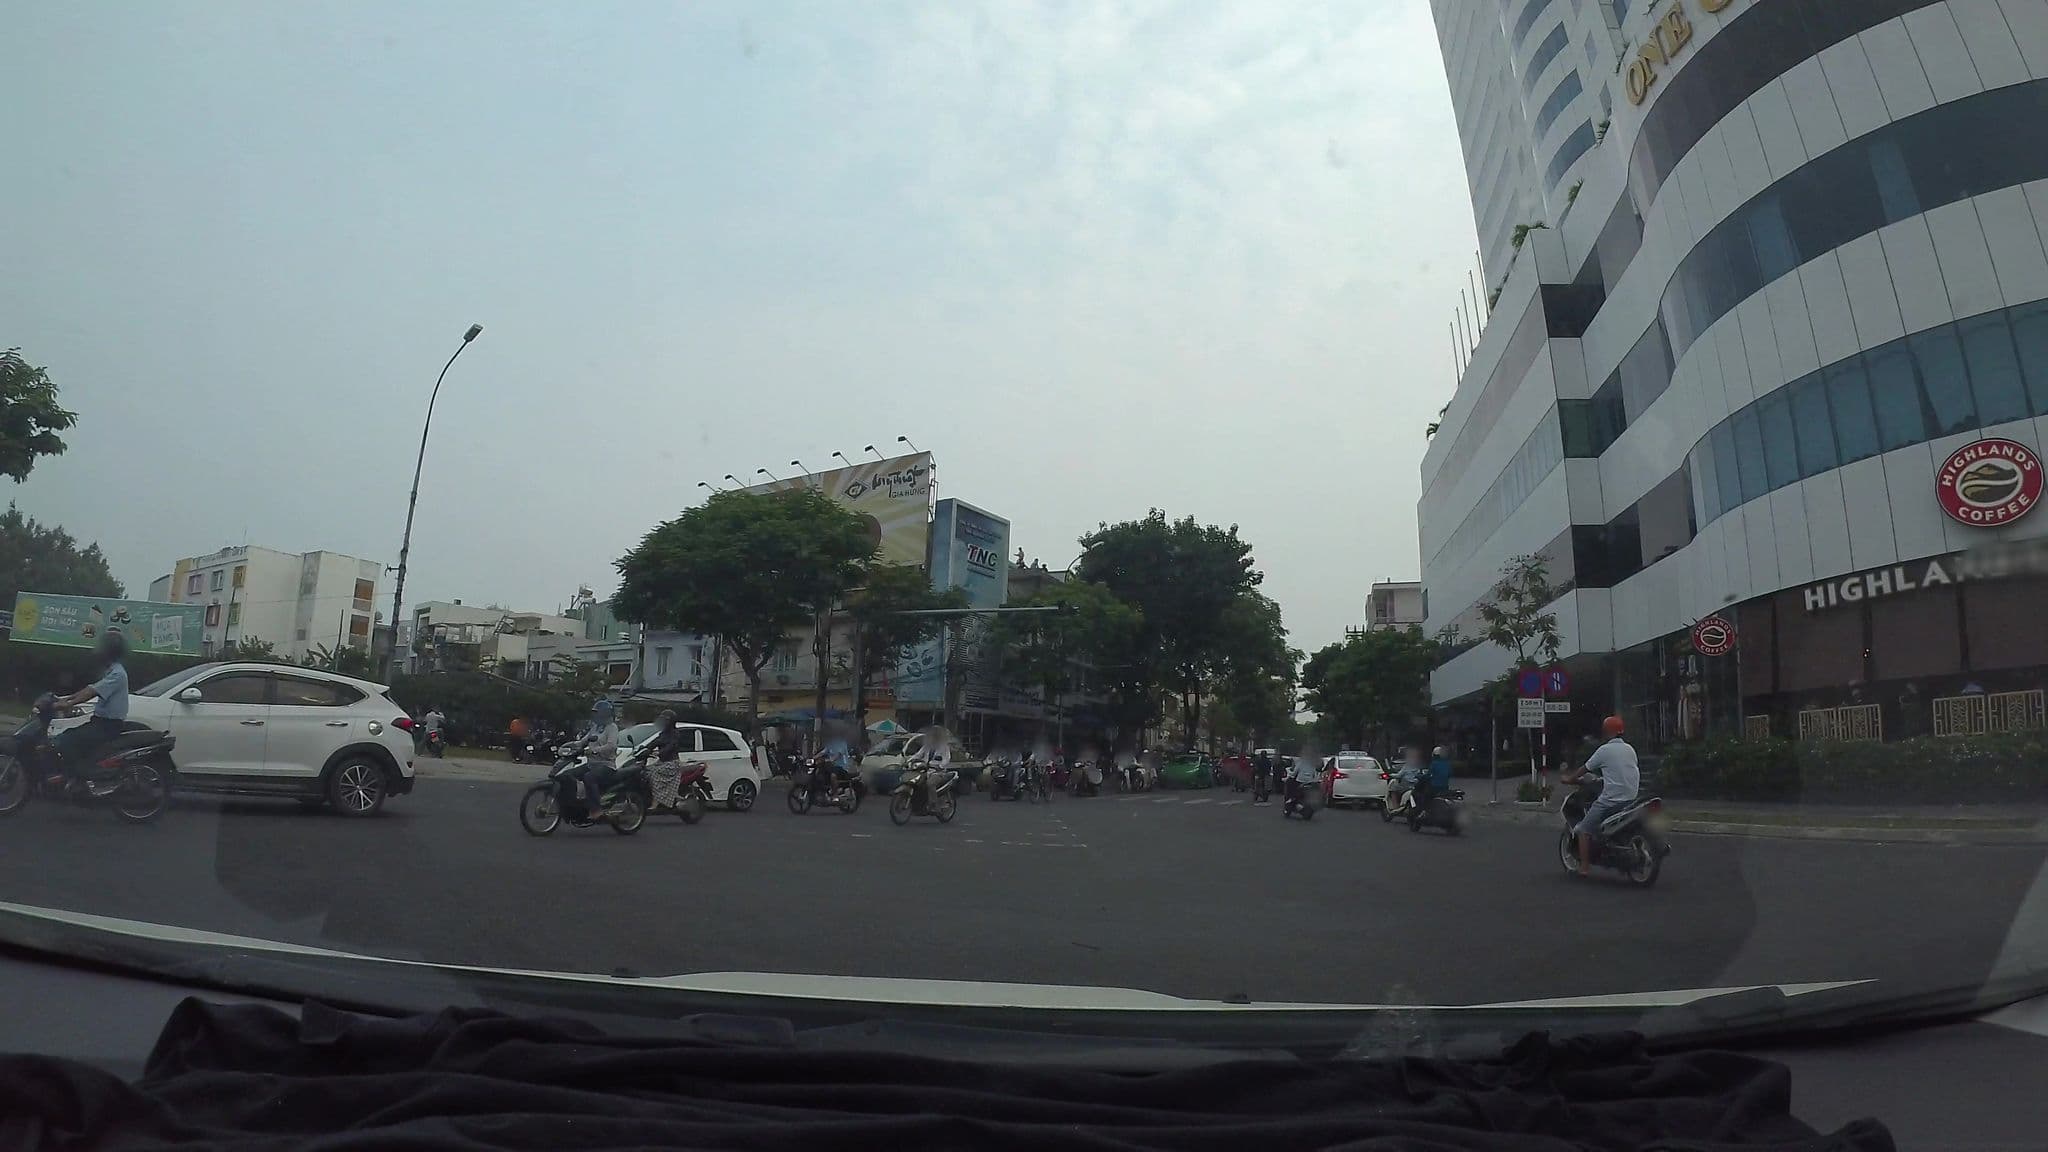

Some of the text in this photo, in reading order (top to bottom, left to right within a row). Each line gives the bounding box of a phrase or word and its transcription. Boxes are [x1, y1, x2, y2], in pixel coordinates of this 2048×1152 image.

[1626, 0, 1693, 106] ONE
[1942, 444, 2035, 486] HIGHLANDS
[1958, 493, 2030, 521] COFFEE
[967, 544, 998, 567] TNC
